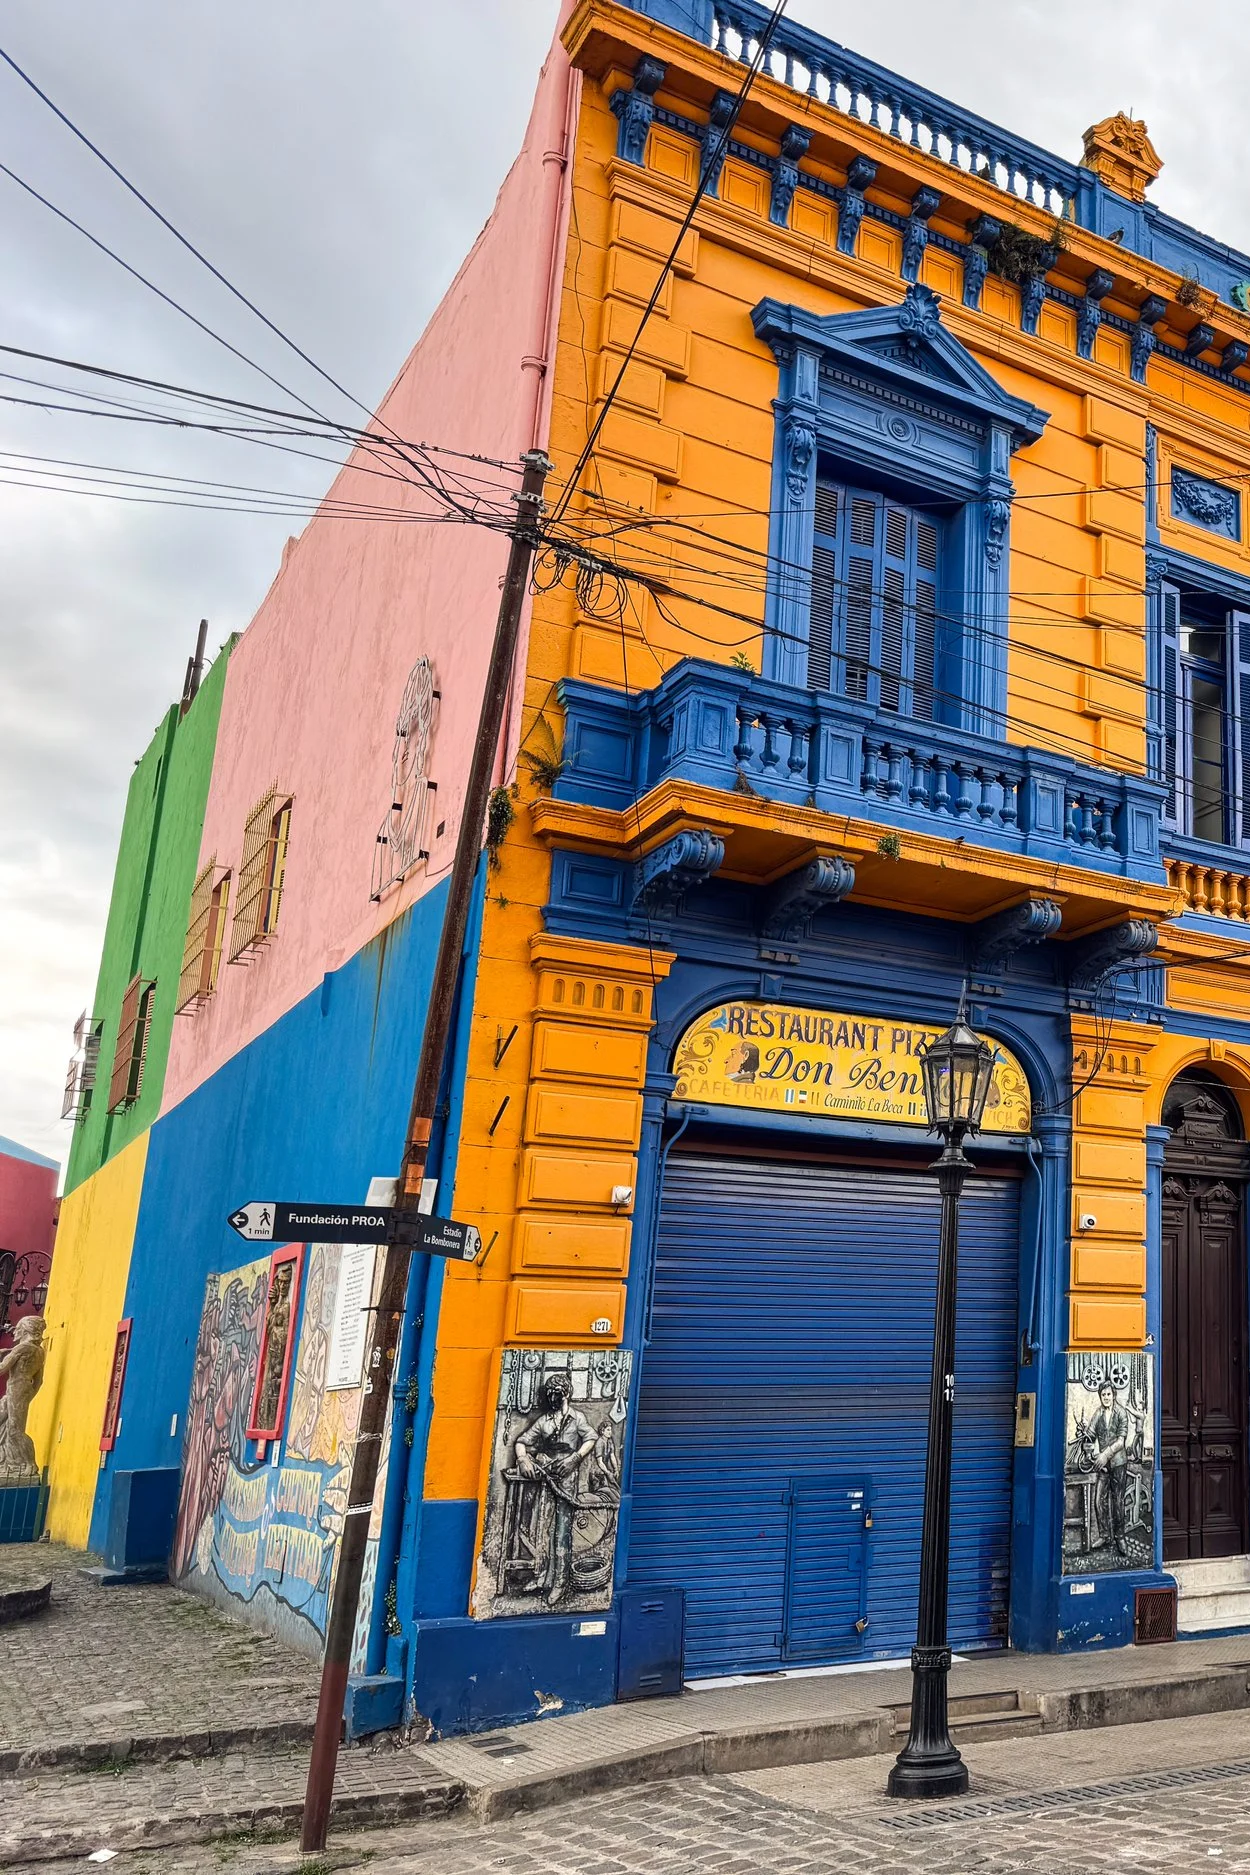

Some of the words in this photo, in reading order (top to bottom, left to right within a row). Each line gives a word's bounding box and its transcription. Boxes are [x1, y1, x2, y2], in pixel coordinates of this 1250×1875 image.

[728, 1005, 884, 1053] RESTAURANT
[759, 1046, 833, 1086] Don
[689, 1078, 781, 1102] CAFETERIA
[824, 1094, 866, 1111] Caminito
[867, 1100, 880, 1112] La
[288, 1213, 349, 1226] Fundación
[351, 1215, 386, 1227] PROA
[254, 1227, 270, 1235] min
[424, 1233, 431, 1244] La
[431, 1235, 460, 1249] Bombonera
[594, 1321, 608, 1331] 1271
[945, 1374, 954, 1387] 10
